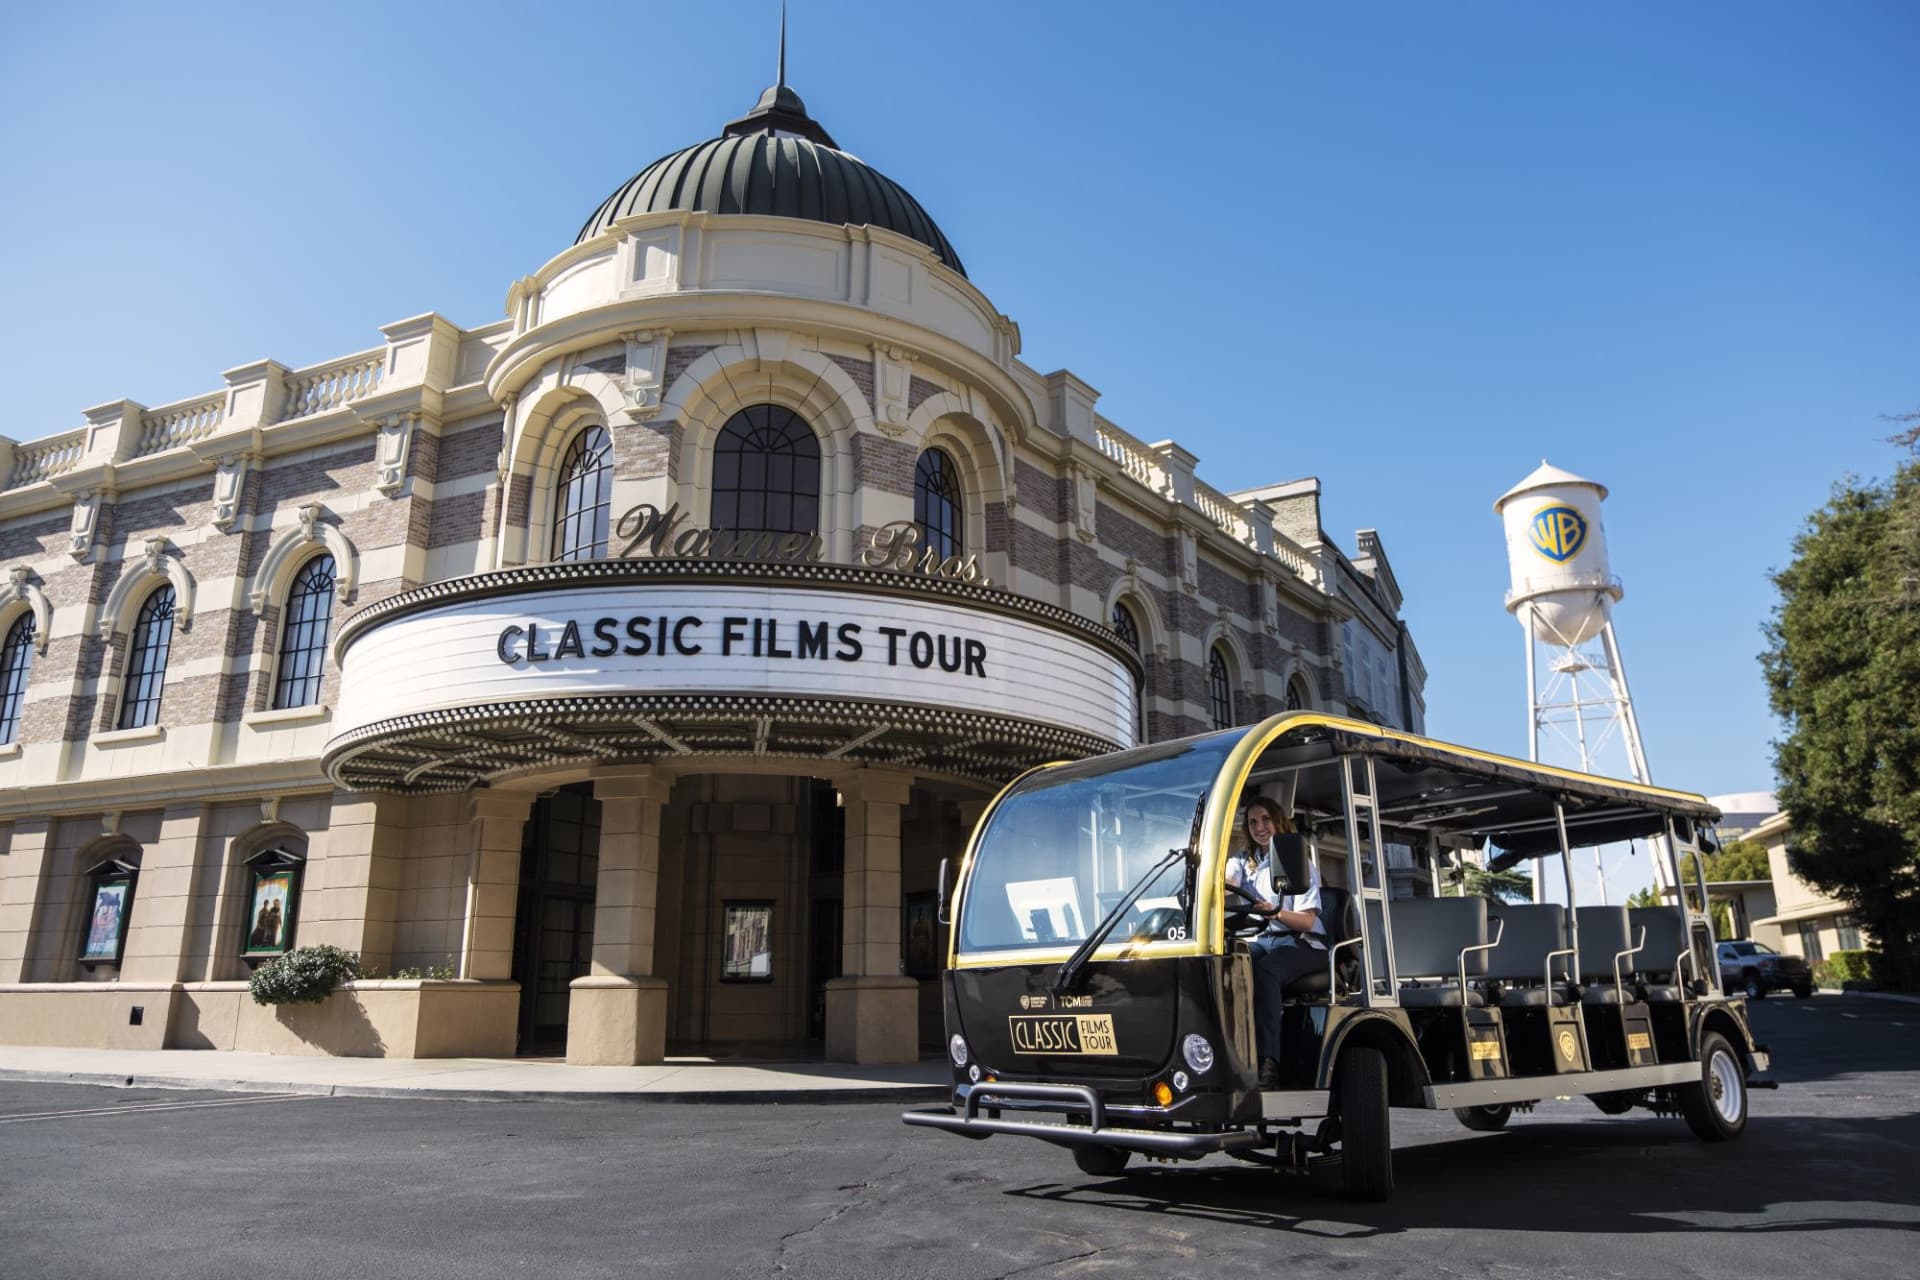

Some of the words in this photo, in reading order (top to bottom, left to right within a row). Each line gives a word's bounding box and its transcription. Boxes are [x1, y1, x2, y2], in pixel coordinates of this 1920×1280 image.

[615, 501, 824, 562] Warner
[862, 520, 993, 586] Bros.
[1533, 512, 1582, 556] WB
[497, 616, 703, 664] CLASSIC
[722, 618, 862, 662] FILMS
[879, 626, 987, 678] TOUR
[1167, 926, 1186, 940] 05
[1060, 995, 1080, 1008] TCM
[1016, 1021, 1077, 1049] CLASSIC
[1080, 1020, 1109, 1034] FILMS
[1083, 1036, 1112, 1049] TOUR
